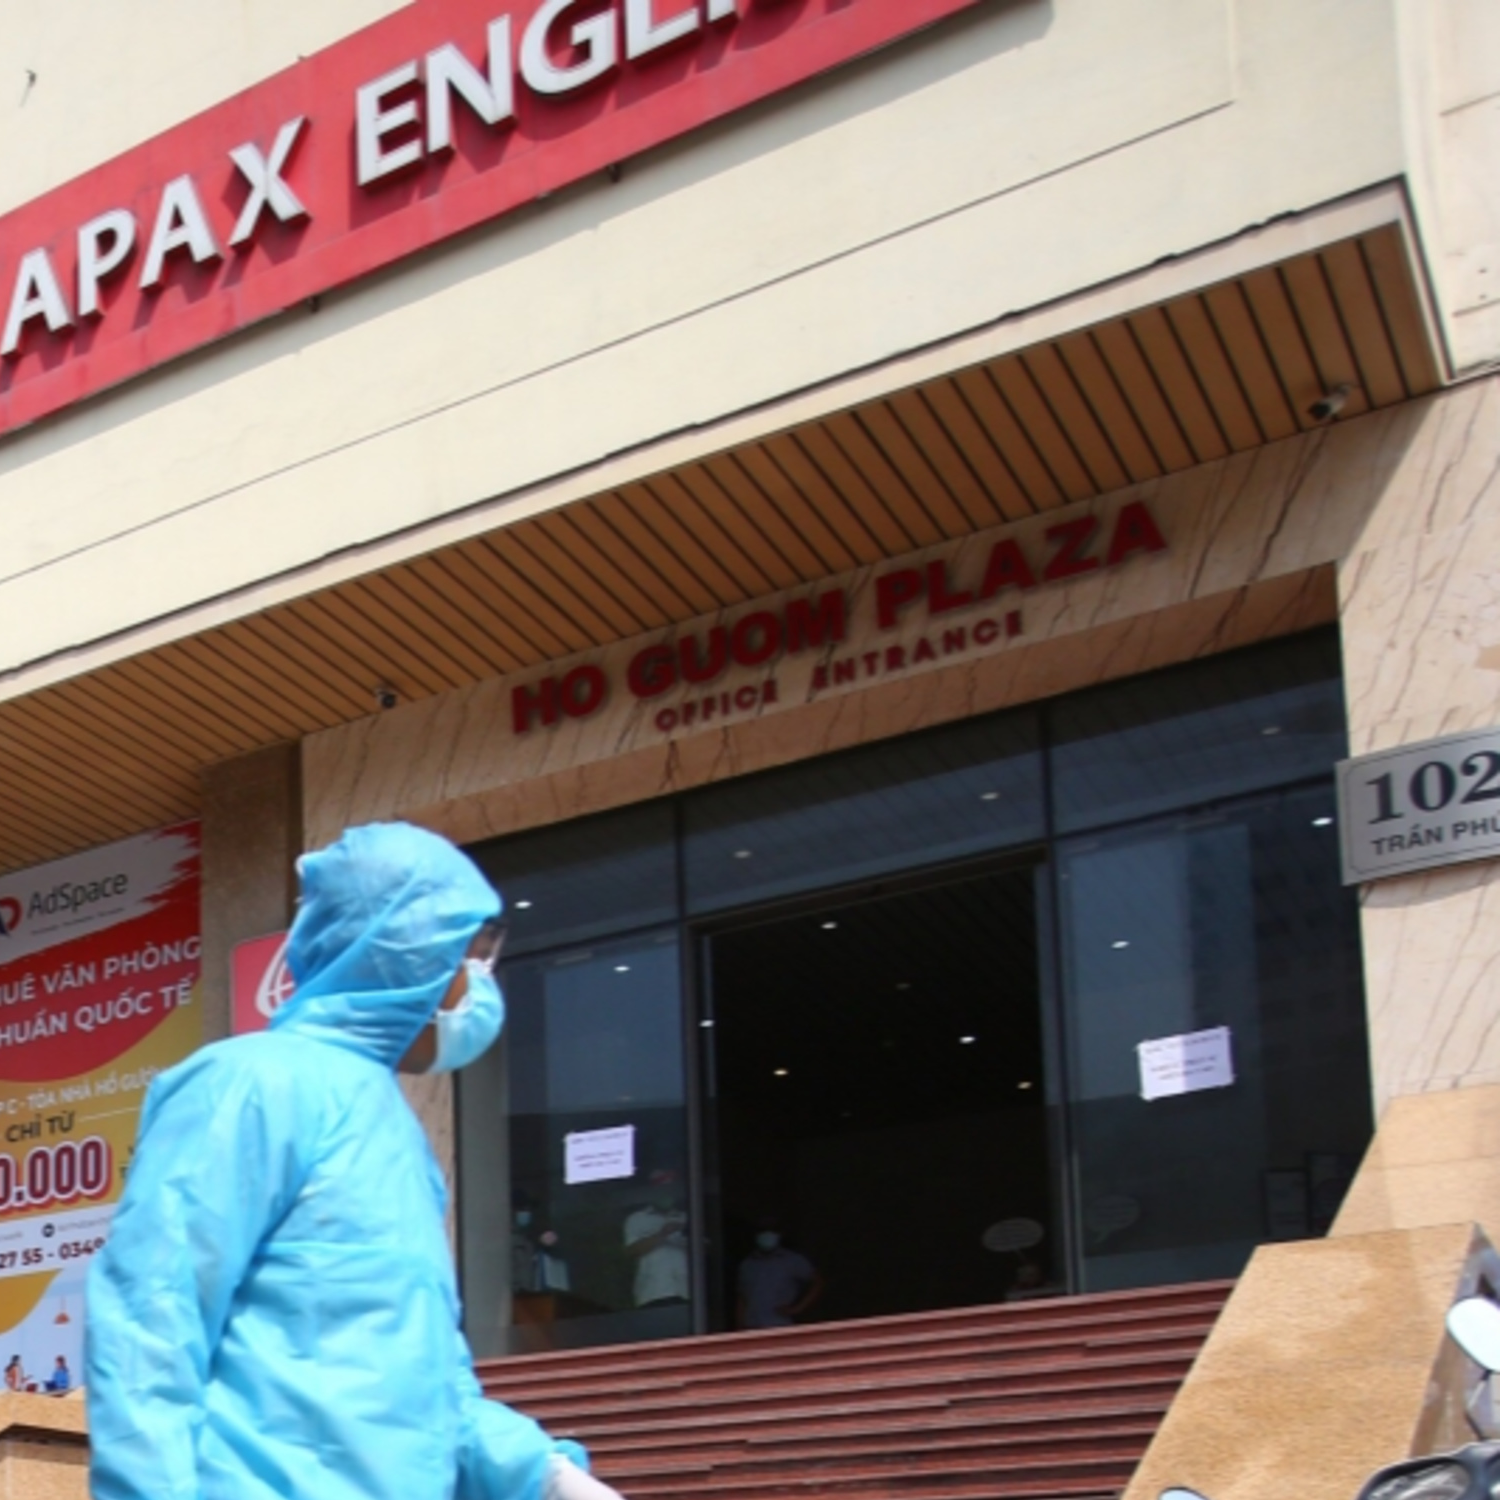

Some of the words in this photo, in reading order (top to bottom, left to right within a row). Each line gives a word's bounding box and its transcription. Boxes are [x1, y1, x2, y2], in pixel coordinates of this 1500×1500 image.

[356, 0, 738, 188] ENGL
[509, 664, 606, 735] HO
[626, 588, 847, 698] GUOM
[874, 499, 1168, 630] PLAZA
[654, 679, 779, 734] OFFICE
[811, 609, 1025, 692] ENTRANCE
[1365, 750, 1500, 825] 102
[27, 872, 128, 919] AdSpace
[41, 961, 97, 994] VĂN
[103, 936, 201, 980] PHÒNG
[74, 986, 153, 1032] QUỐC
[158, 972, 196, 1010] TẾ
[4, 1113, 41, 1143] CHỈ
[46, 1110, 77, 1135] TỪ
[22, 1247, 43, 1266] 55
